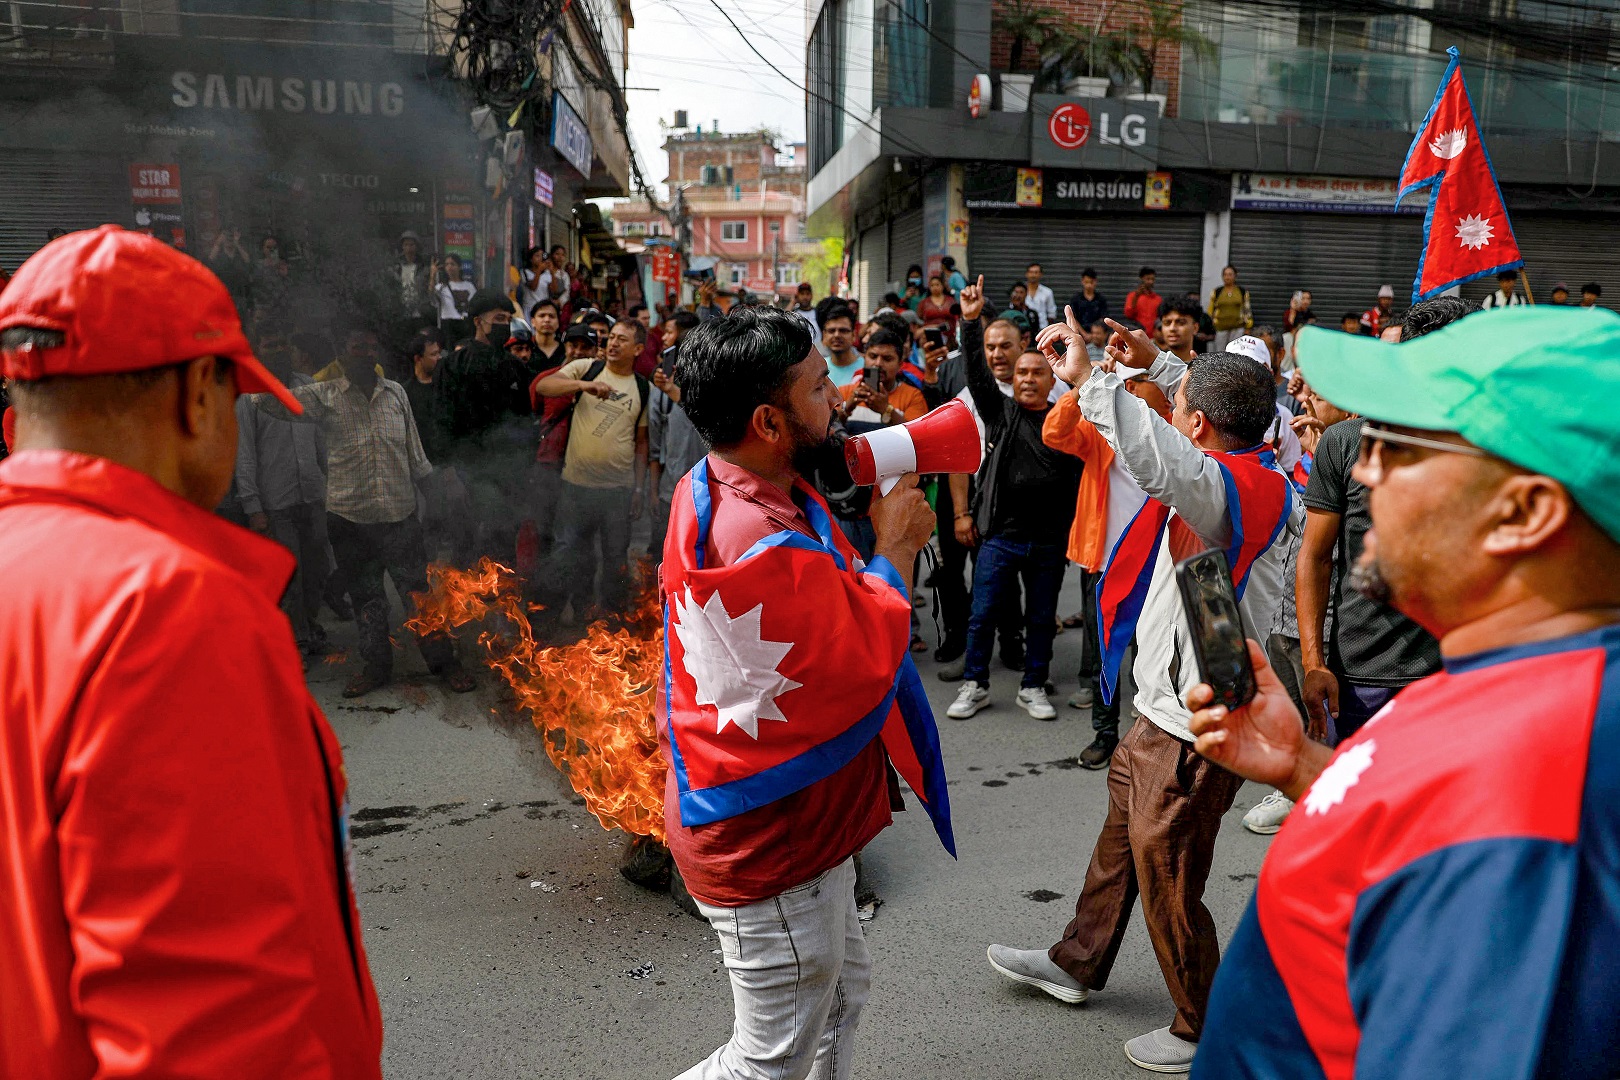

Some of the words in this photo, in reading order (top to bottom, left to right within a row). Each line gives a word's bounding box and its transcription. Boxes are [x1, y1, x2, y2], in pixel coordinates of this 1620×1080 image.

[171, 71, 405, 117] SAMSUNG
[124, 123, 148, 134] Star
[149, 124, 187, 136] Mobile
[189, 126, 216, 137] Zone
[1099, 112, 1147, 147] LG
[139, 169, 171, 186] STAR
[1056, 181, 1143, 199] SAMSUNG
[152, 212, 182, 223] iPhone
